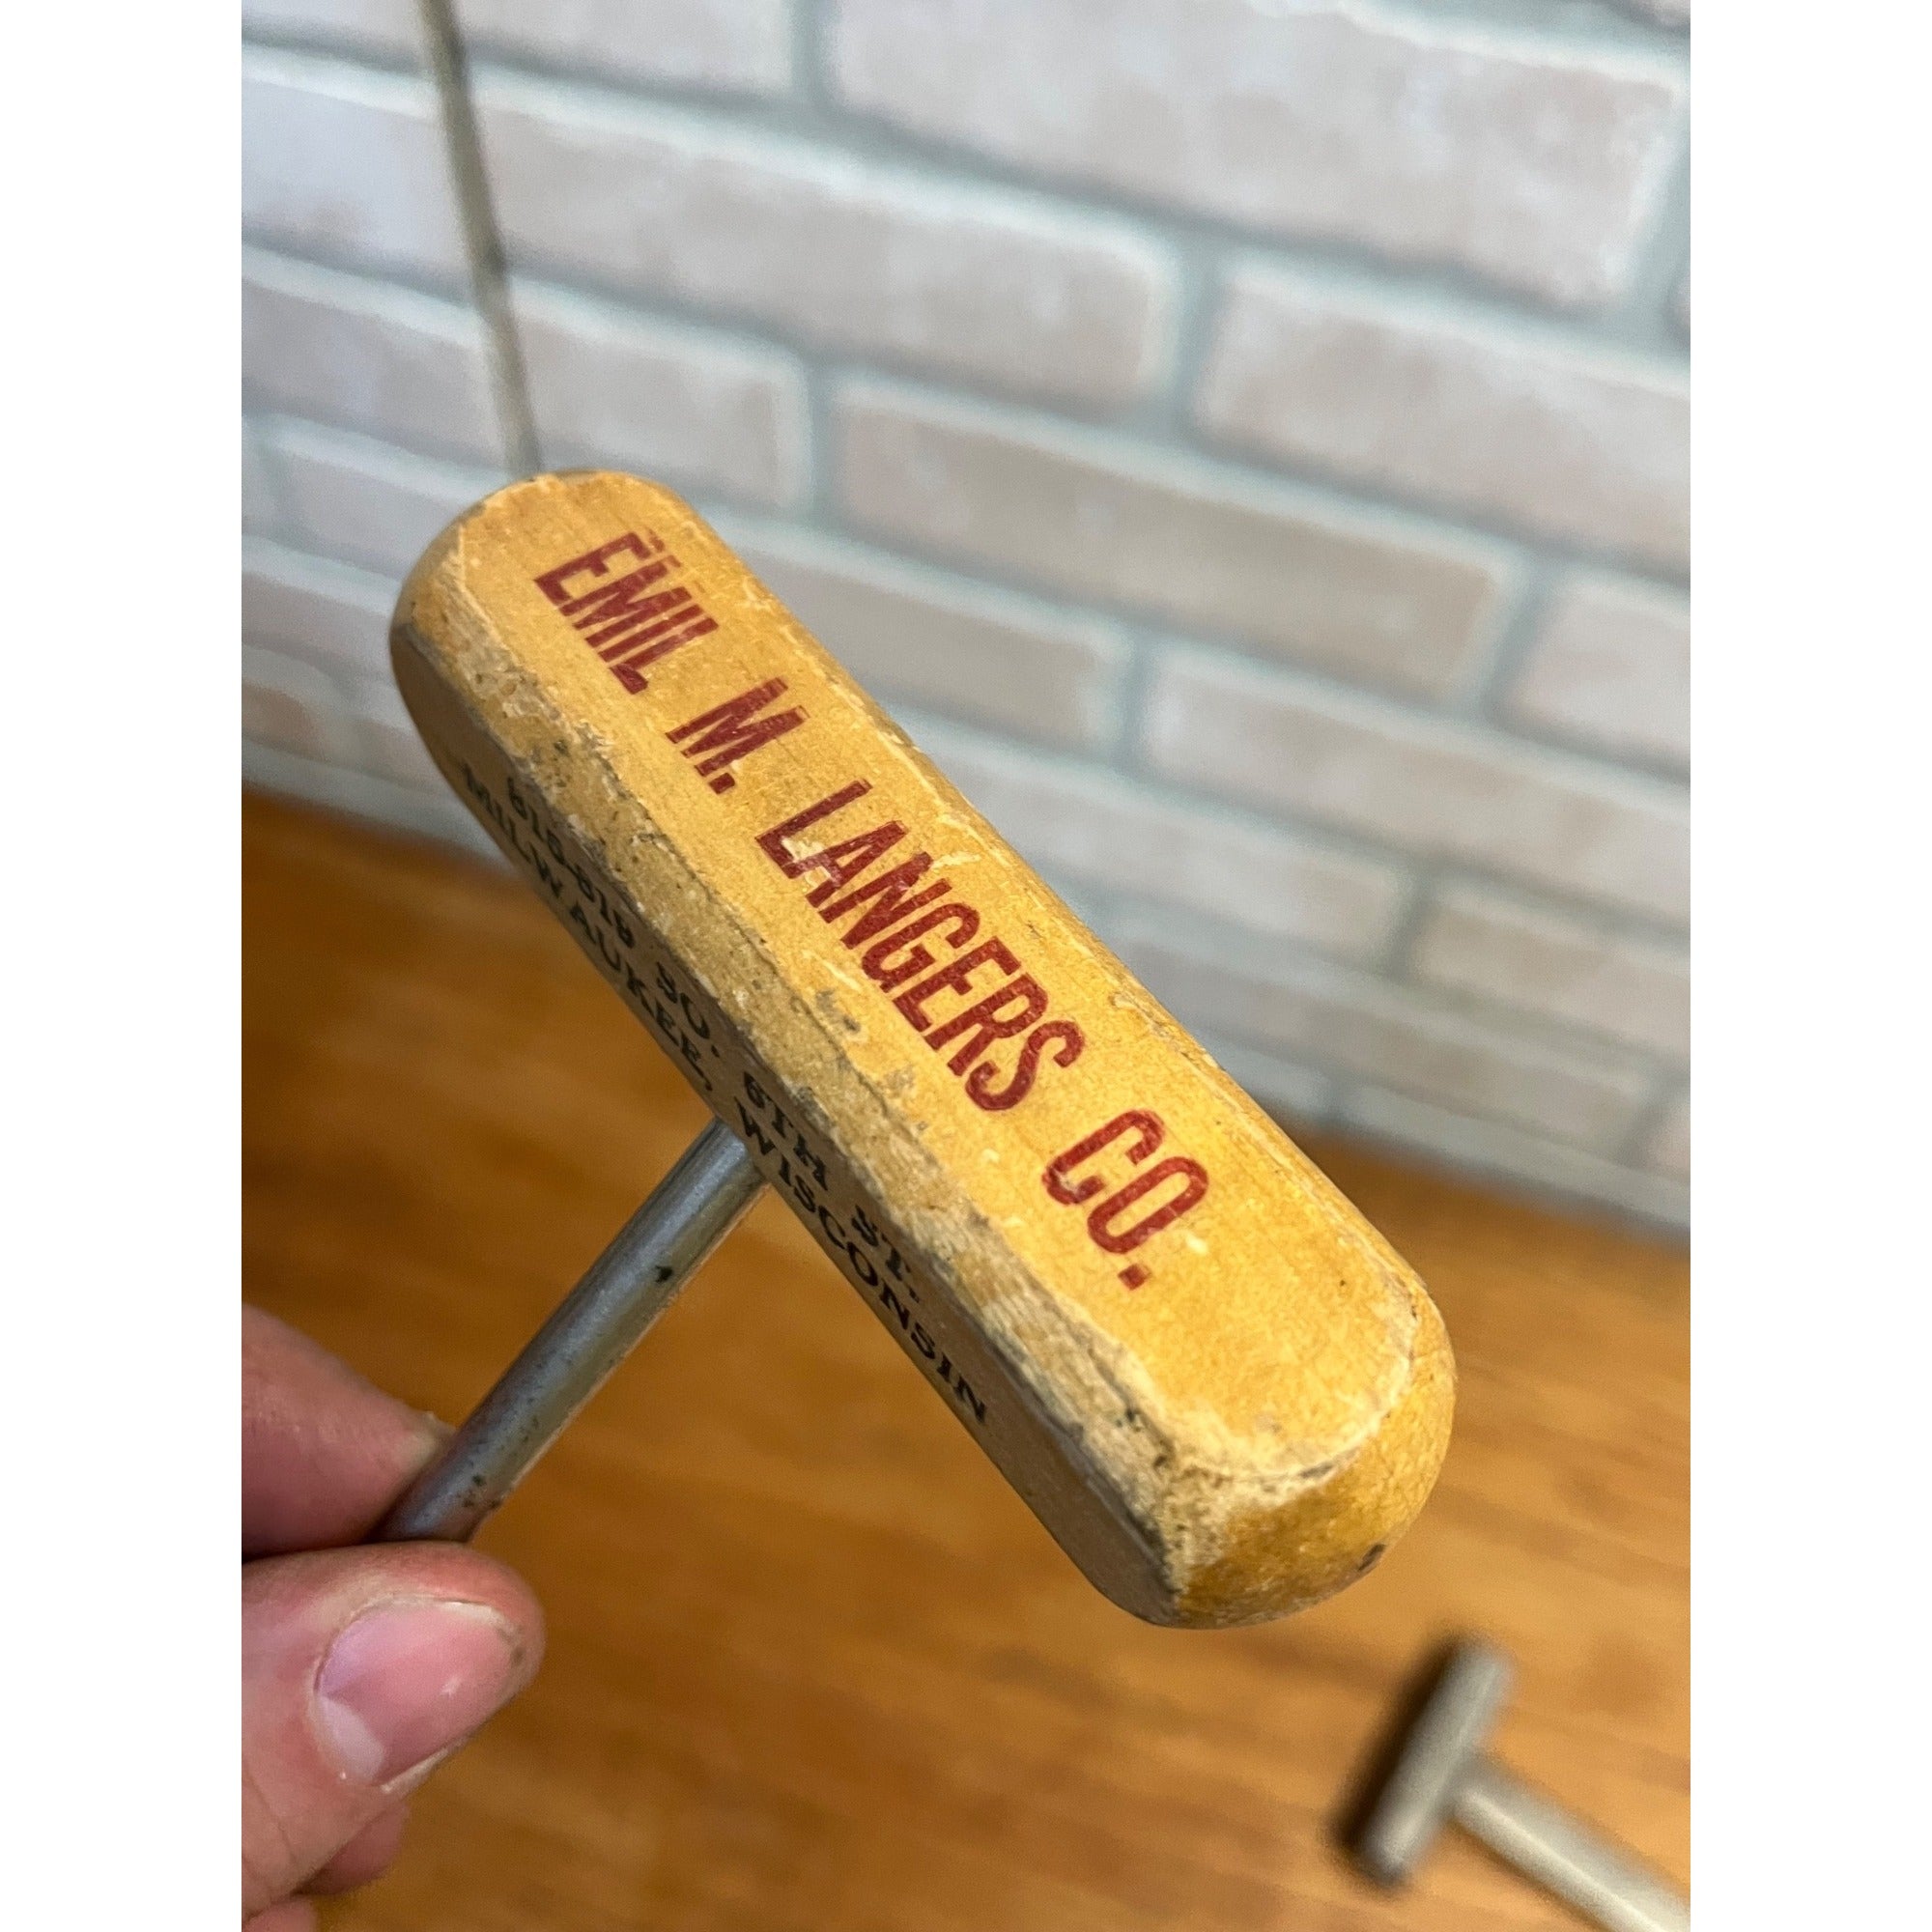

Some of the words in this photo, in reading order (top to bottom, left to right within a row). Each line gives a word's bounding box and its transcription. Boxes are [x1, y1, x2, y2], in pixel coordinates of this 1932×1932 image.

[533, 528, 719, 695] EMIL
[666, 677, 810, 795] M.
[755, 778, 1086, 1113] LANGERS
[1041, 1109, 1209, 1290] CO.
[656, 961, 721, 1059] SO.
[743, 1071, 829, 1191] 6TH
[851, 1205, 921, 1303] ST.
[734, 1096, 987, 1424] WISCONSIN
